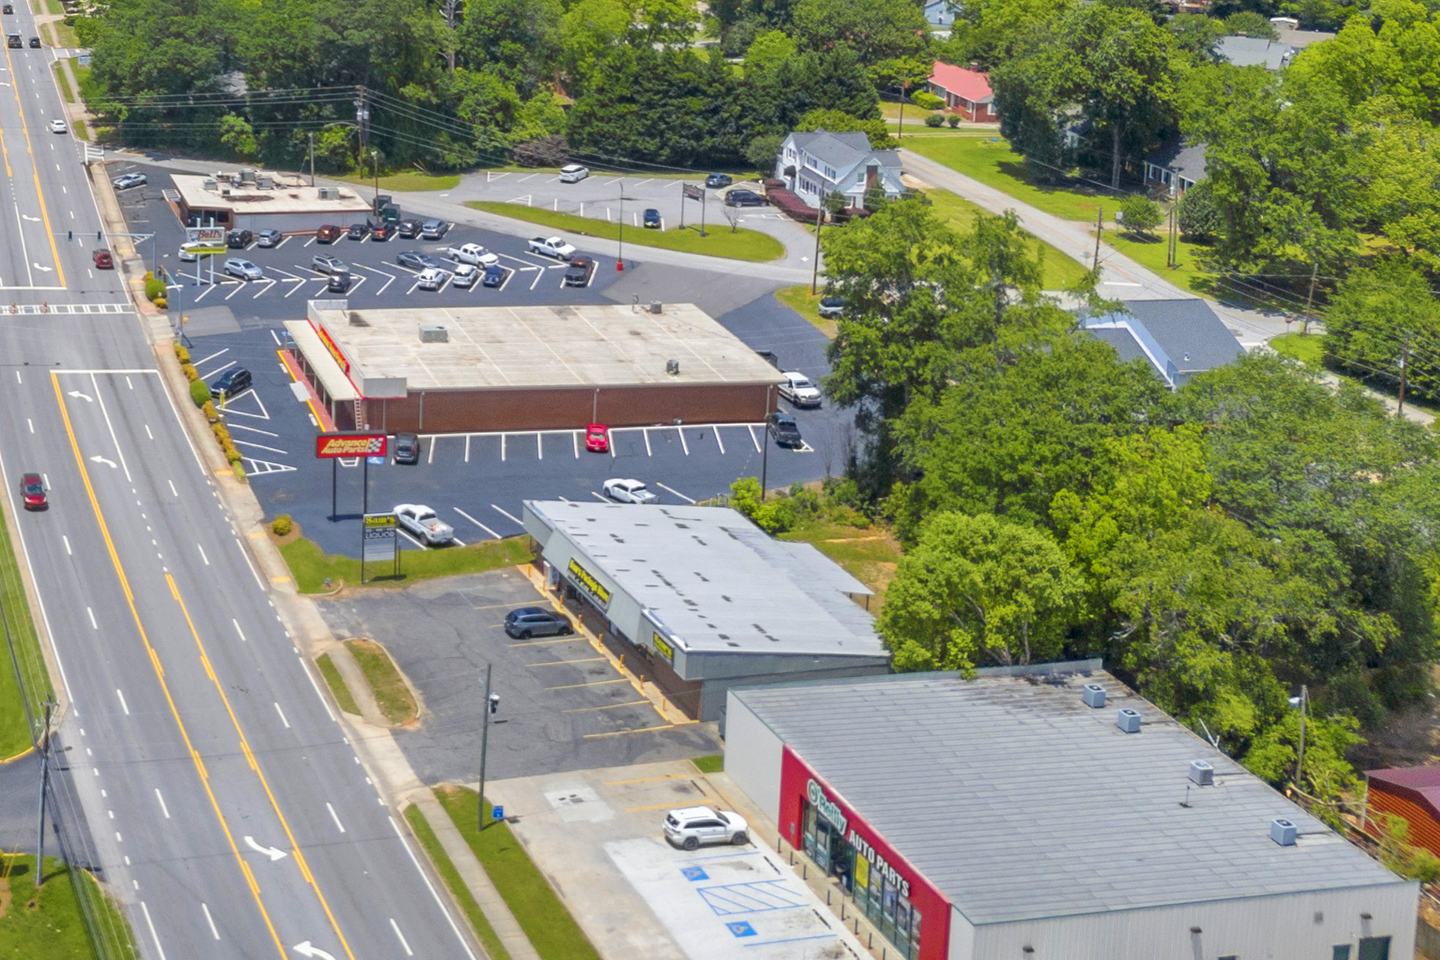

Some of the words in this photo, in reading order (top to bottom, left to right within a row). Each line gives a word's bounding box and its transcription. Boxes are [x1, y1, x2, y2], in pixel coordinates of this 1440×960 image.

[321, 446, 343, 454] Auto
[327, 438, 367, 447] Advance
[807, 778, 848, 836] O'Reilly
[849, 829, 875, 864] AUTO
[876, 854, 910, 898] PARTS
